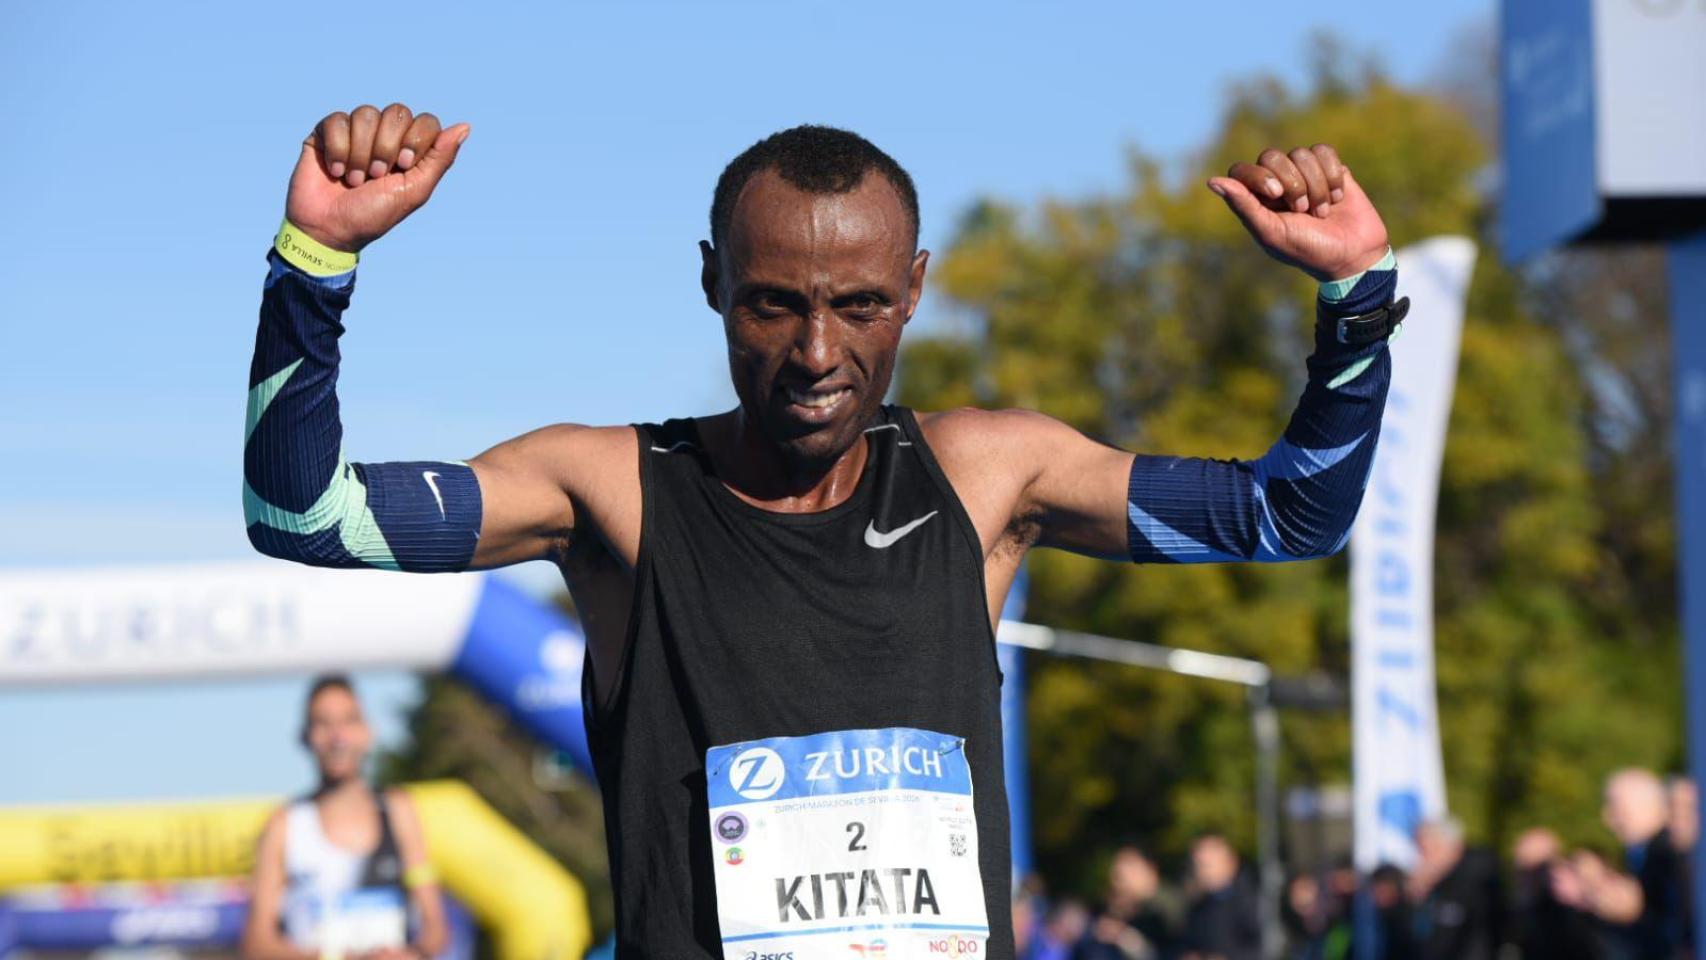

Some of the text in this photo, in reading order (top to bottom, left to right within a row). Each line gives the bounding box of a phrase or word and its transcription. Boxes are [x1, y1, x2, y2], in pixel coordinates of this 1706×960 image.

[292, 245, 322, 265] SEVILLA
[804, 747, 943, 781] ZURICH
[867, 795, 901, 804] SEVIA
[846, 821, 867, 851] 2
[775, 867, 940, 922] KITATA
